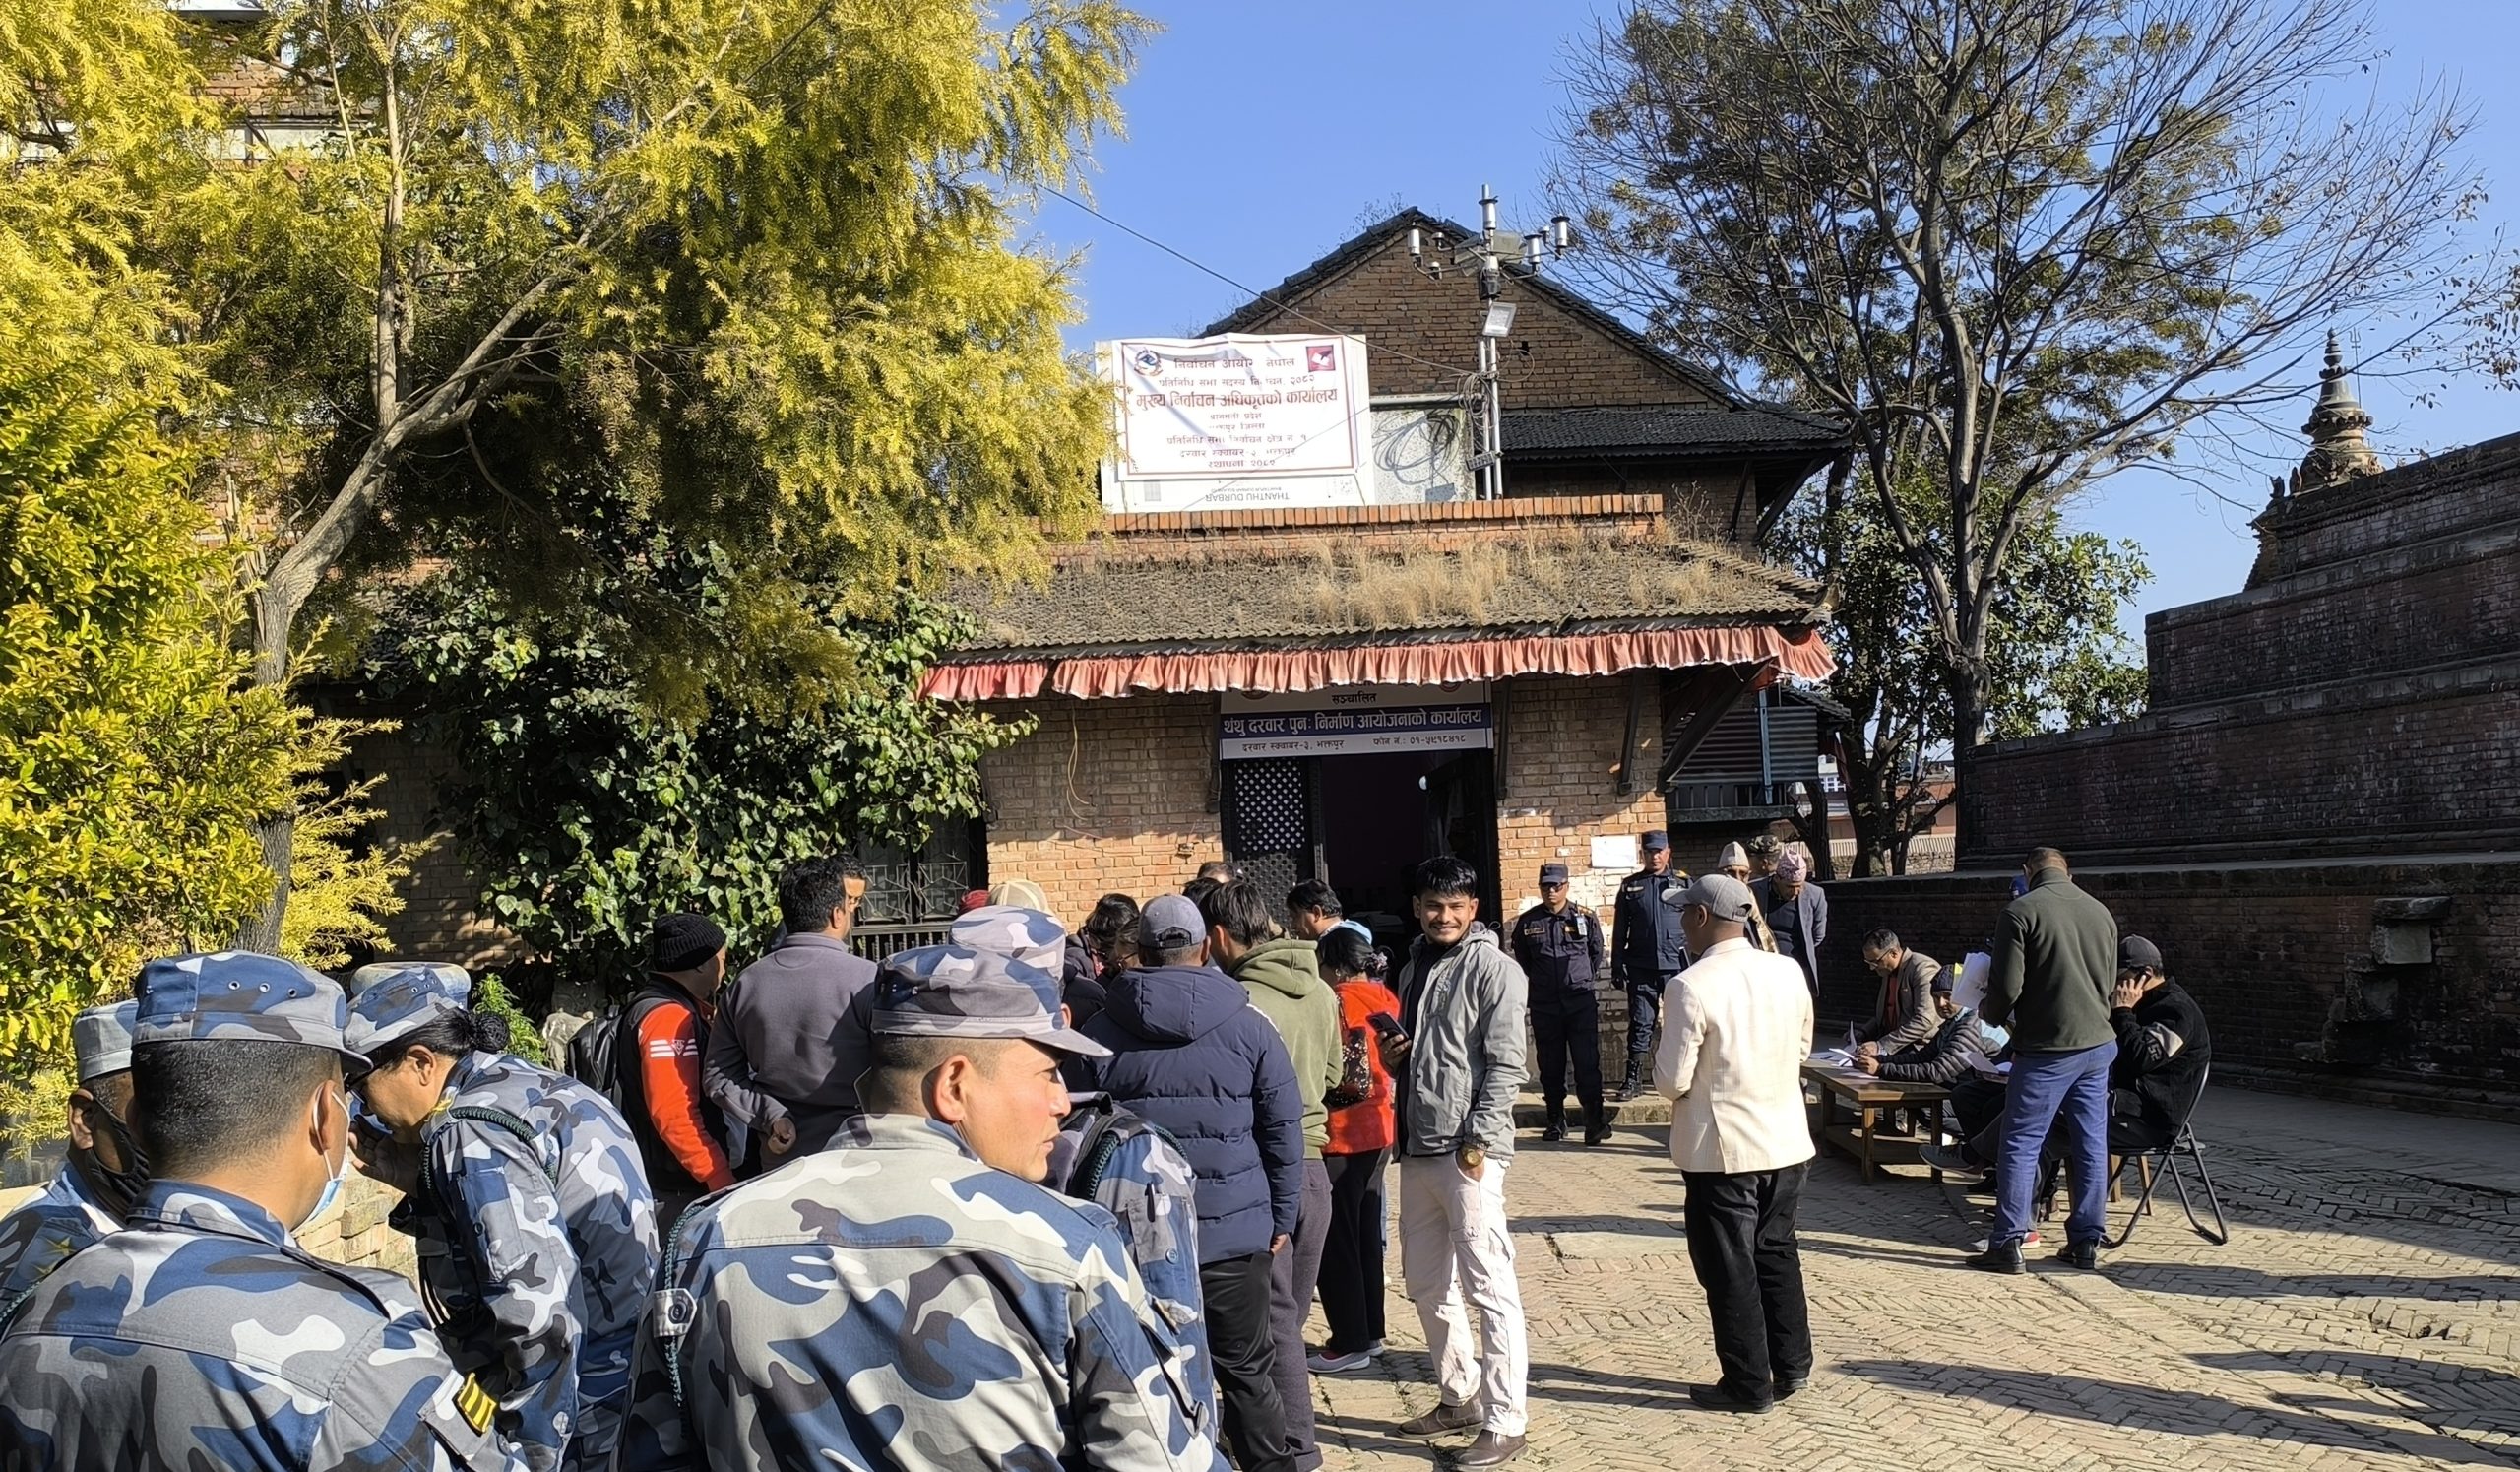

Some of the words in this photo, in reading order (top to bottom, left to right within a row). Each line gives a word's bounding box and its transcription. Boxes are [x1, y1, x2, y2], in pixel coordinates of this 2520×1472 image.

[1173, 358, 1216, 369] निर्वाचन
[1266, 357, 1295, 367] नेपाल
[1159, 377, 1194, 387] प्रतिनिधि
[1199, 378, 1217, 387] सभा
[1222, 378, 1245, 388] सदस्य
[1136, 393, 1166, 411] मुख्य
[1170, 390, 1215, 407] निर्वाचन
[1220, 390, 1282, 409] अधिकृतको
[1287, 386, 1338, 404] कार्यालय
[1244, 411, 1262, 419] प्रदेश
[1166, 434, 1203, 444] प्रतिनिधि
[1204, 493, 1244, 502] DURBAR
[1245, 492, 1290, 501] THANTHU
[1331, 690, 1377, 705] सञ्चालित
[1224, 717, 1246, 736] थंथु
[1315, 712, 1354, 730] निर्माण
[1357, 708, 1427, 728] आयोजनाको
[1430, 706, 1482, 726] कार्यालय
[1373, 736, 1390, 746] फोन
